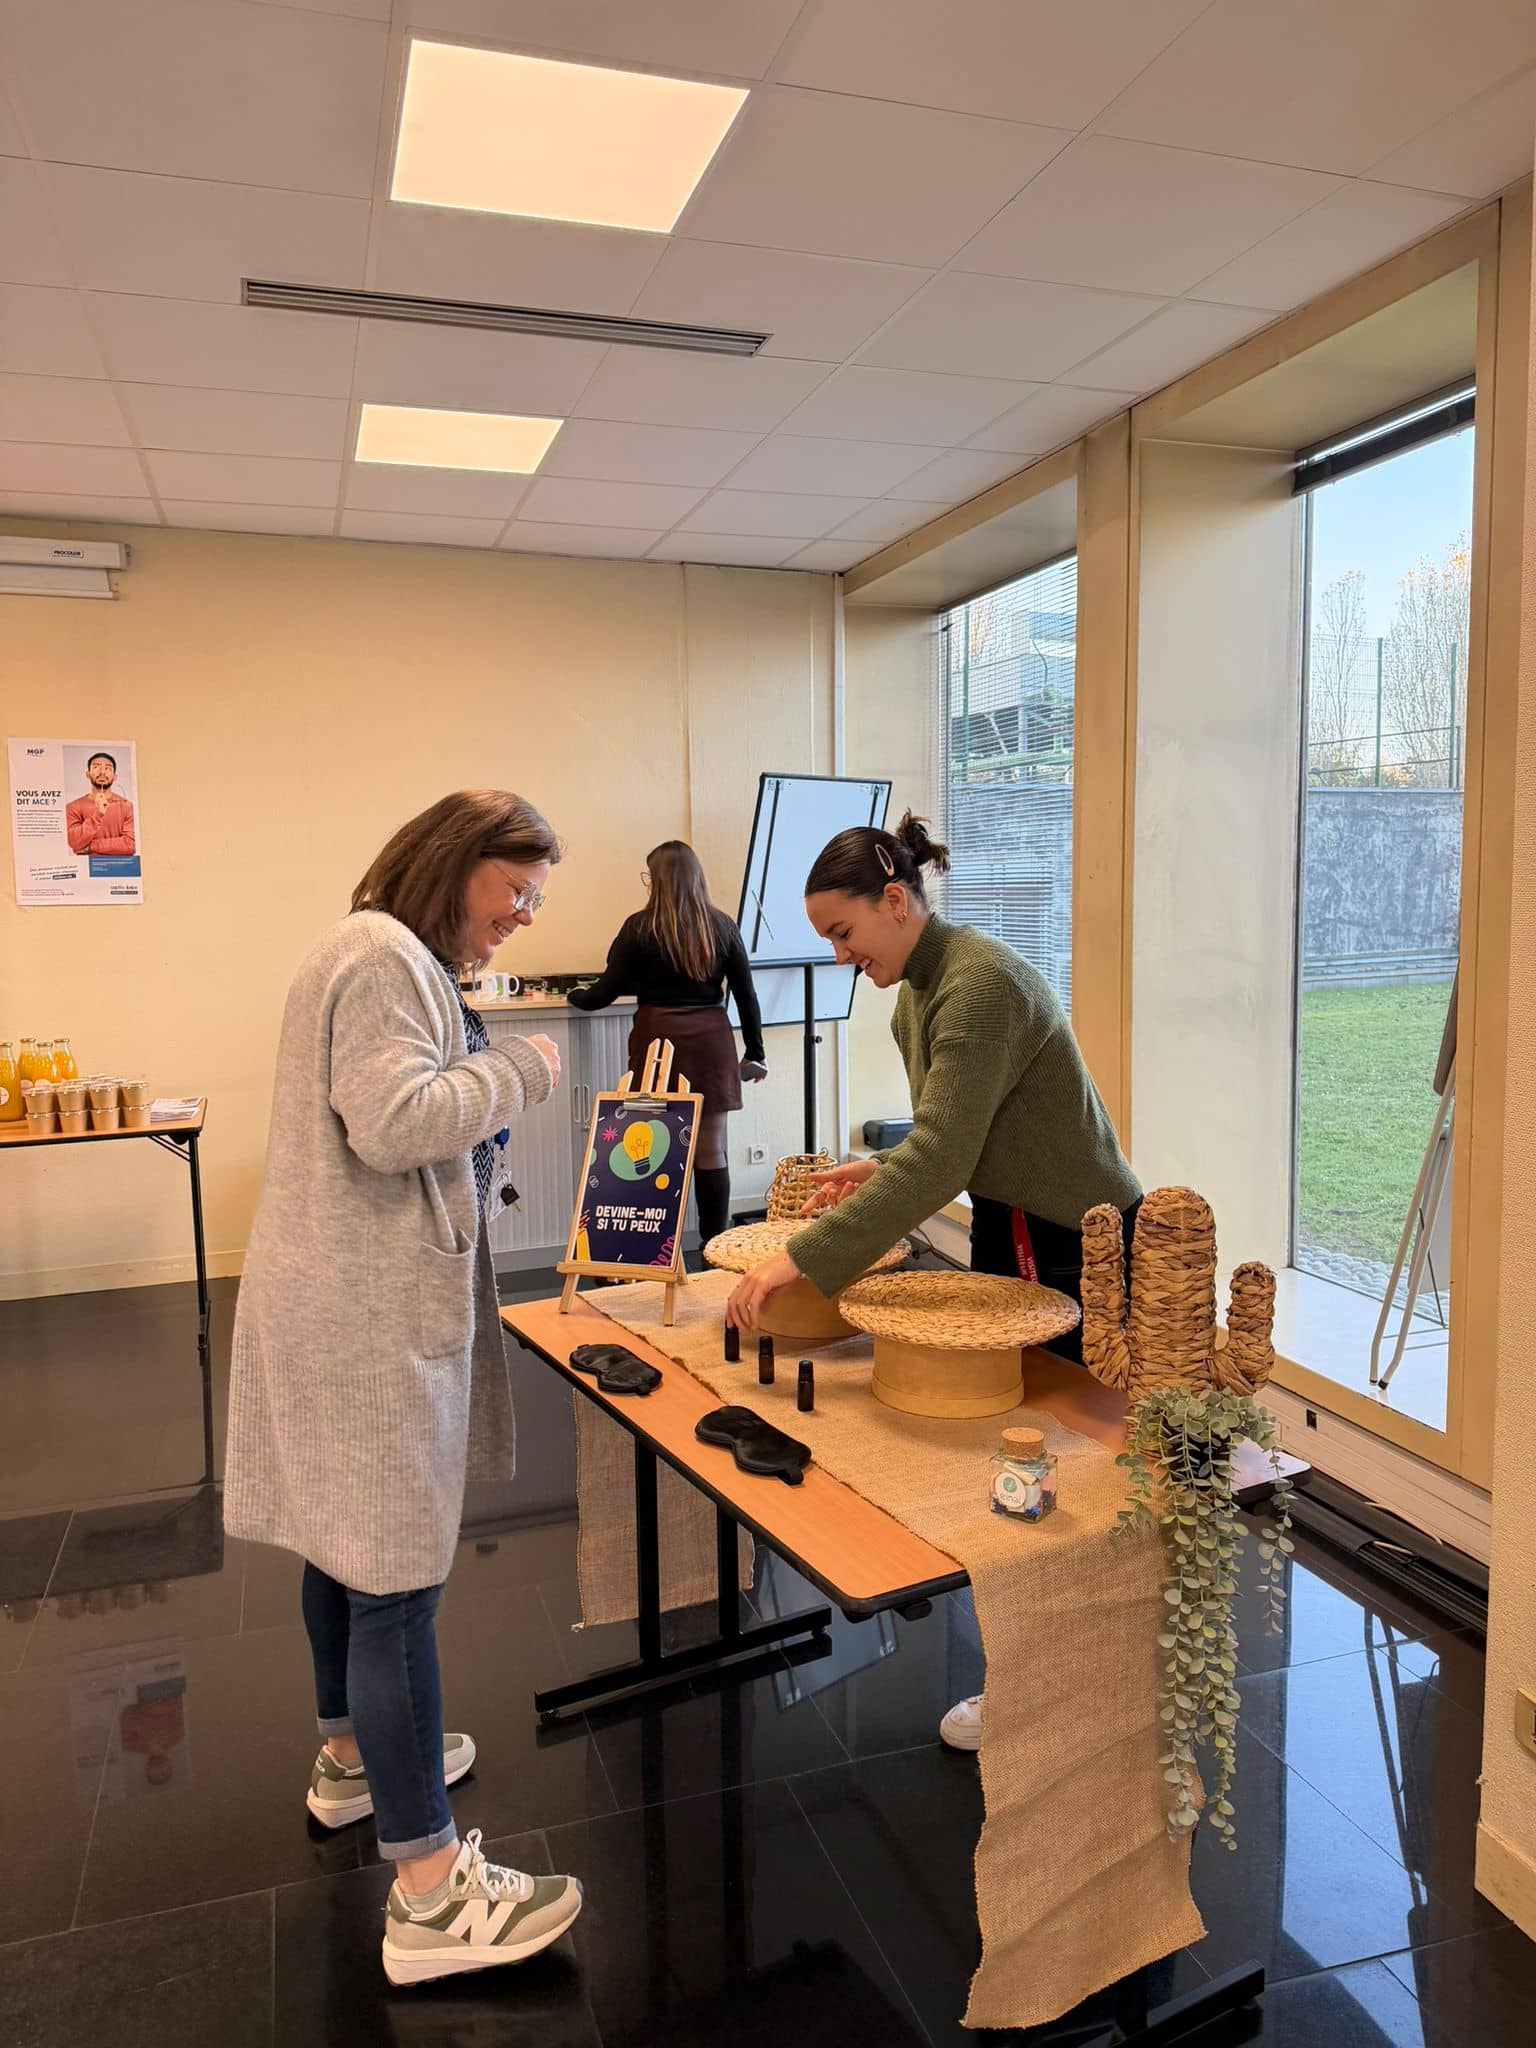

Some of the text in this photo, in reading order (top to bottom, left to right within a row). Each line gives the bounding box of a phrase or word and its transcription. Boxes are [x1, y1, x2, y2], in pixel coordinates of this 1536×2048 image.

[16, 790, 62, 798] VOUS AVEZ
[16, 798, 30, 806] DIT
[31, 798, 50, 806] MCE
[595, 1205, 667, 1221] DEVINE-MOI
[596, 1218, 661, 1233] SI TU PEUX
